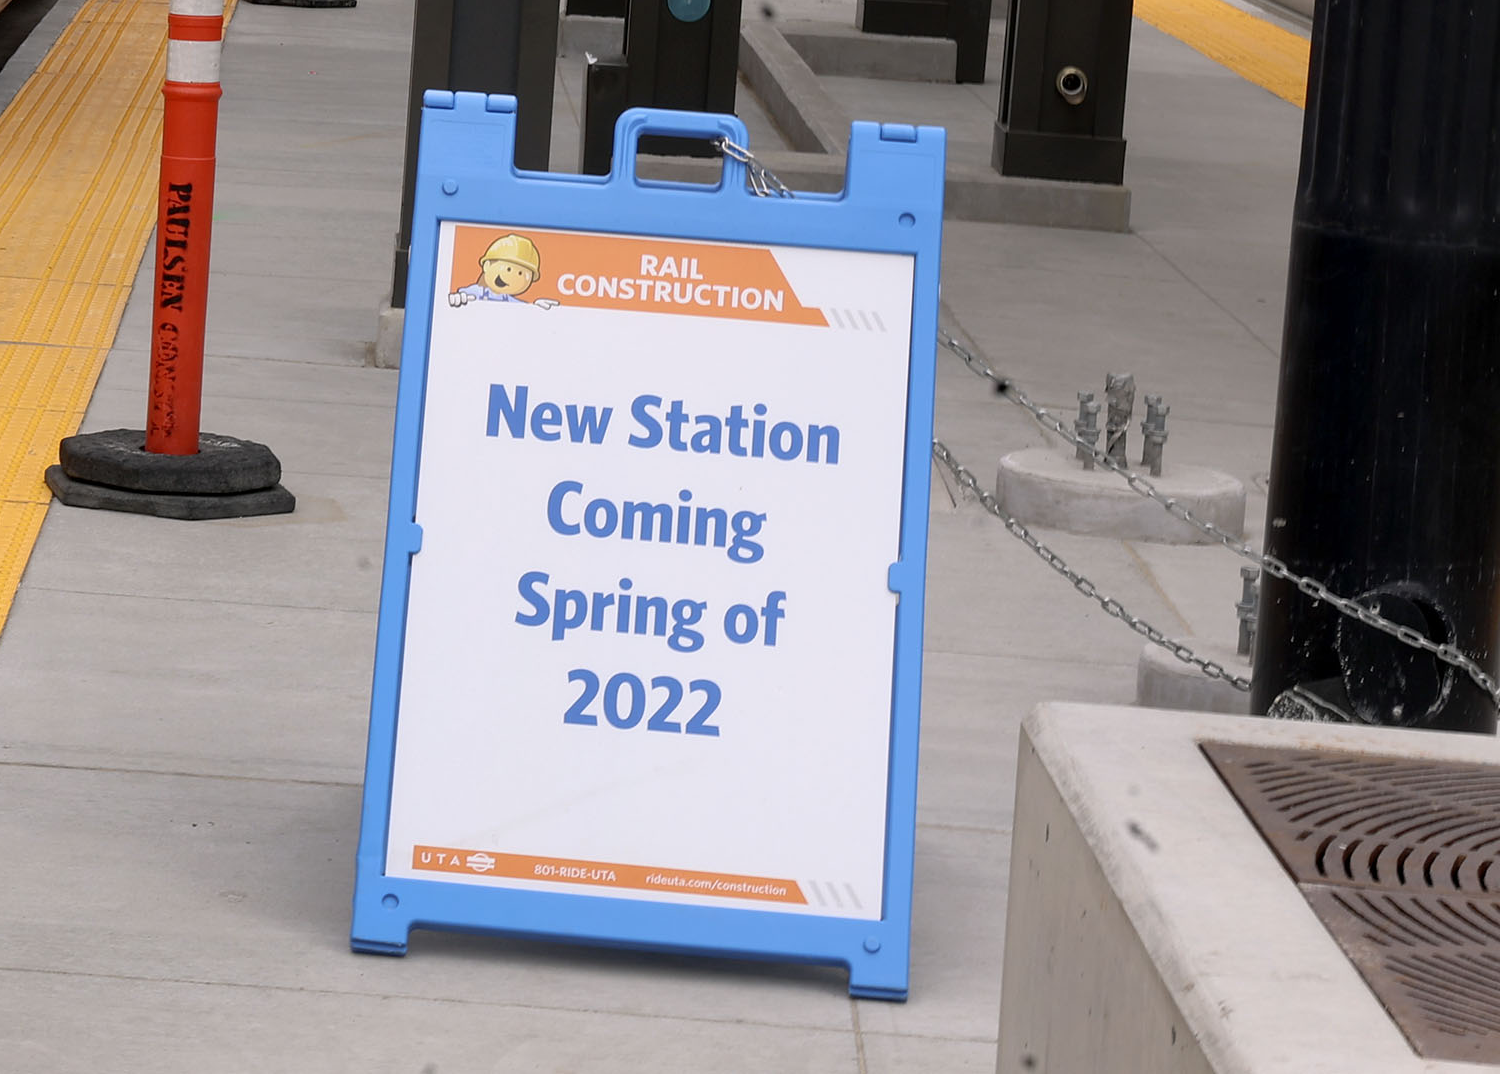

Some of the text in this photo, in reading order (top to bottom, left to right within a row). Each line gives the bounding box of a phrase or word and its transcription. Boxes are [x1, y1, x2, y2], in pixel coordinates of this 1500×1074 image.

[160, 182, 193, 312] PAULSEN
[640, 254, 704, 280] RAIL
[557, 273, 784, 312] CONSTRUCTION
[485, 383, 841, 465] New Station
[546, 480, 768, 565] Coming
[514, 571, 787, 653] Spring of
[562, 668, 723, 737] 2022
[420, 852, 461, 867] UTA
[533, 863, 617, 882] 801-RIDE-UTA
[645, 873, 788, 897] rideuta.com/construction
